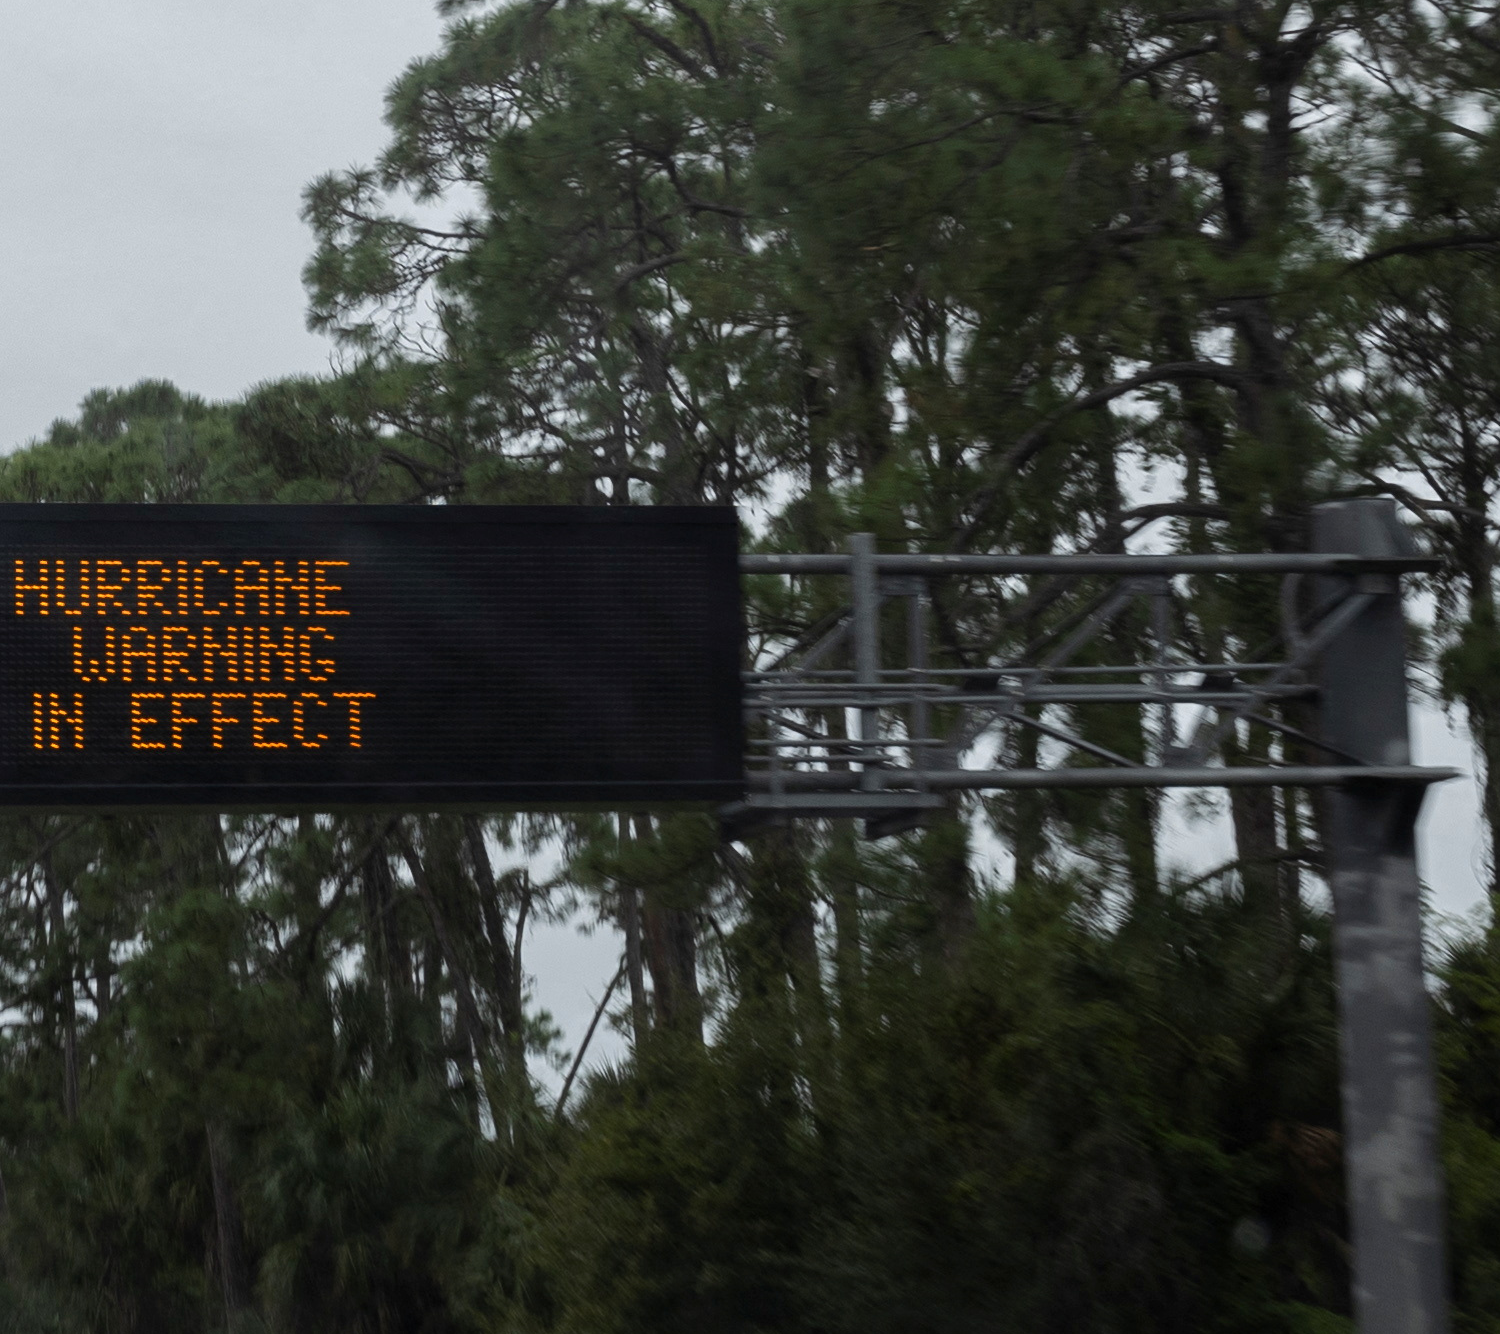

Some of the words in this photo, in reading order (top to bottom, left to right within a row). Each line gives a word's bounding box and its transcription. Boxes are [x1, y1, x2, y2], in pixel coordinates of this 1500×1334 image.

[14, 559, 351, 616] HURRICANE
[72, 625, 336, 682] WARNING
[32, 692, 85, 749] IN
[130, 692, 376, 749] EFFECT
